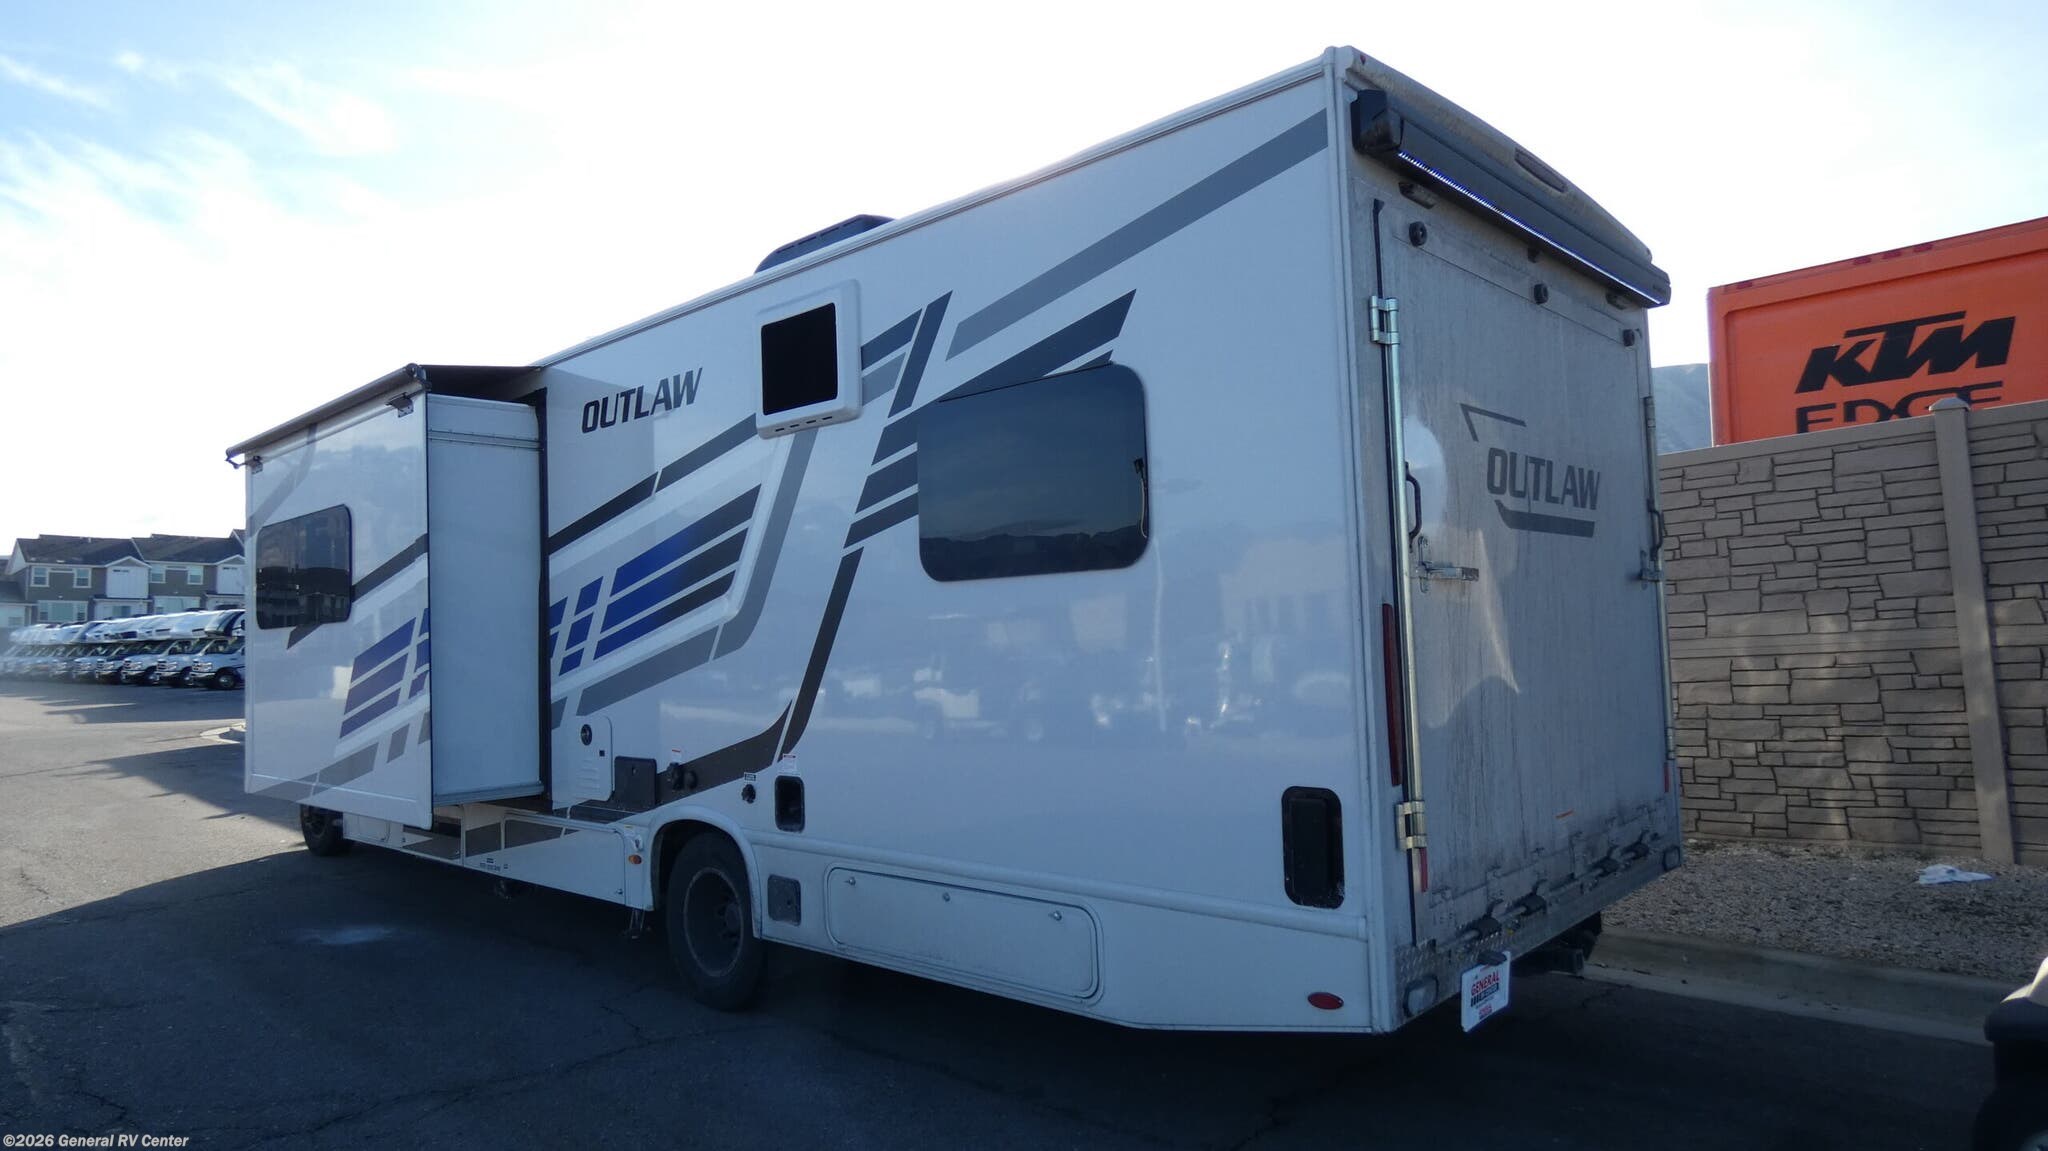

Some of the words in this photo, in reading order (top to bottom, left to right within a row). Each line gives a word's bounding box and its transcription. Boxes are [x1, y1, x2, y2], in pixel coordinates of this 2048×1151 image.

[1795, 310, 2015, 394] KTM
[582, 367, 703, 433] OUTLAW
[1487, 447, 1600, 510] OUTLAW
[1471, 970, 1500, 996] GENERAL
